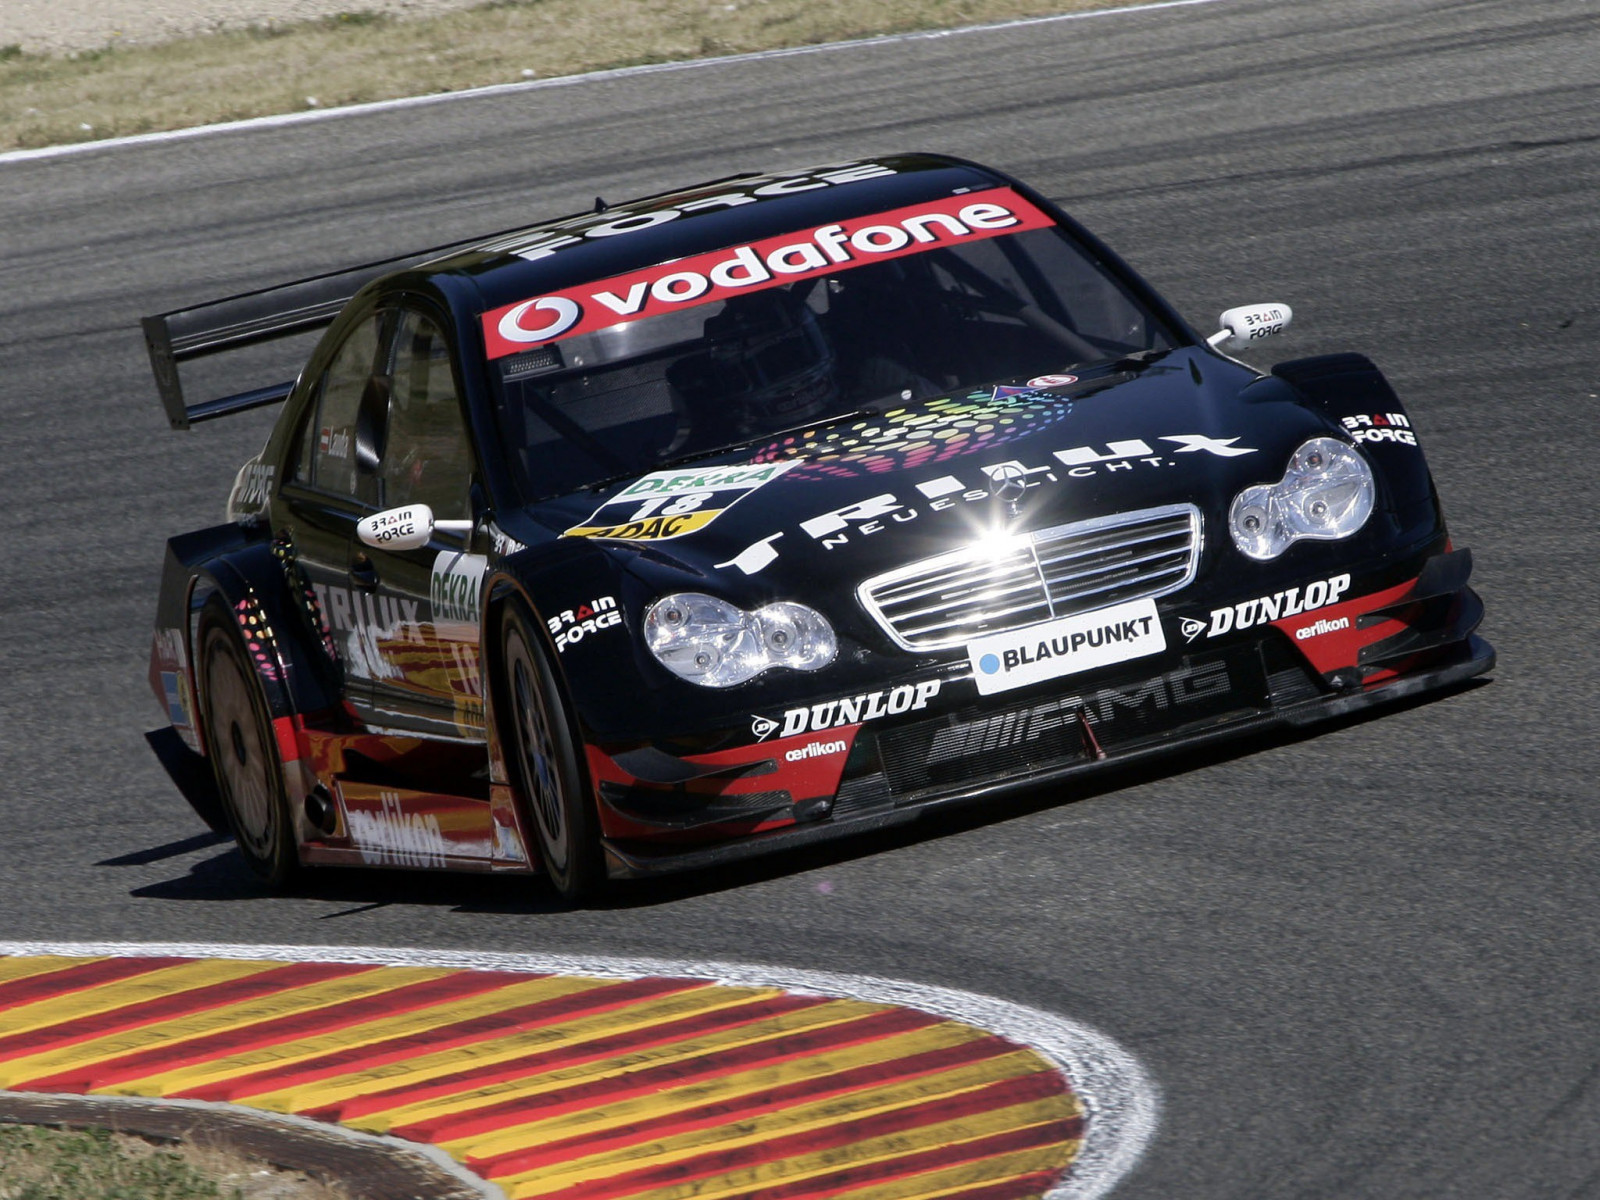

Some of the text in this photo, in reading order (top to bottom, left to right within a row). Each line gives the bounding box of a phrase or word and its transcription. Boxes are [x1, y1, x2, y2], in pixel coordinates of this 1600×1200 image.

[509, 163, 898, 262] FORCE
[591, 202, 1019, 316] vodafone
[1243, 309, 1283, 325] BRAIN
[1249, 323, 1283, 340] FORCE
[1341, 412, 1411, 430] BRAIN
[1350, 428, 1418, 447] FORCE
[619, 467, 776, 497] DEKRA
[370, 510, 413, 532] BRAIN
[629, 491, 714, 522] 18
[713, 434, 1259, 575] TRILUX
[822, 488, 989, 550] NEUES
[374, 523, 415, 544] FORCE
[583, 513, 693, 539] ADAC
[430, 571, 479, 622] DEKRA
[547, 595, 616, 635] BRAIN
[1206, 573, 1351, 638] DUNLOP
[554, 609, 623, 653] FORCE
[1003, 616, 1154, 673] BLAUPUNKT
[779, 678, 942, 738] DUNLOP
